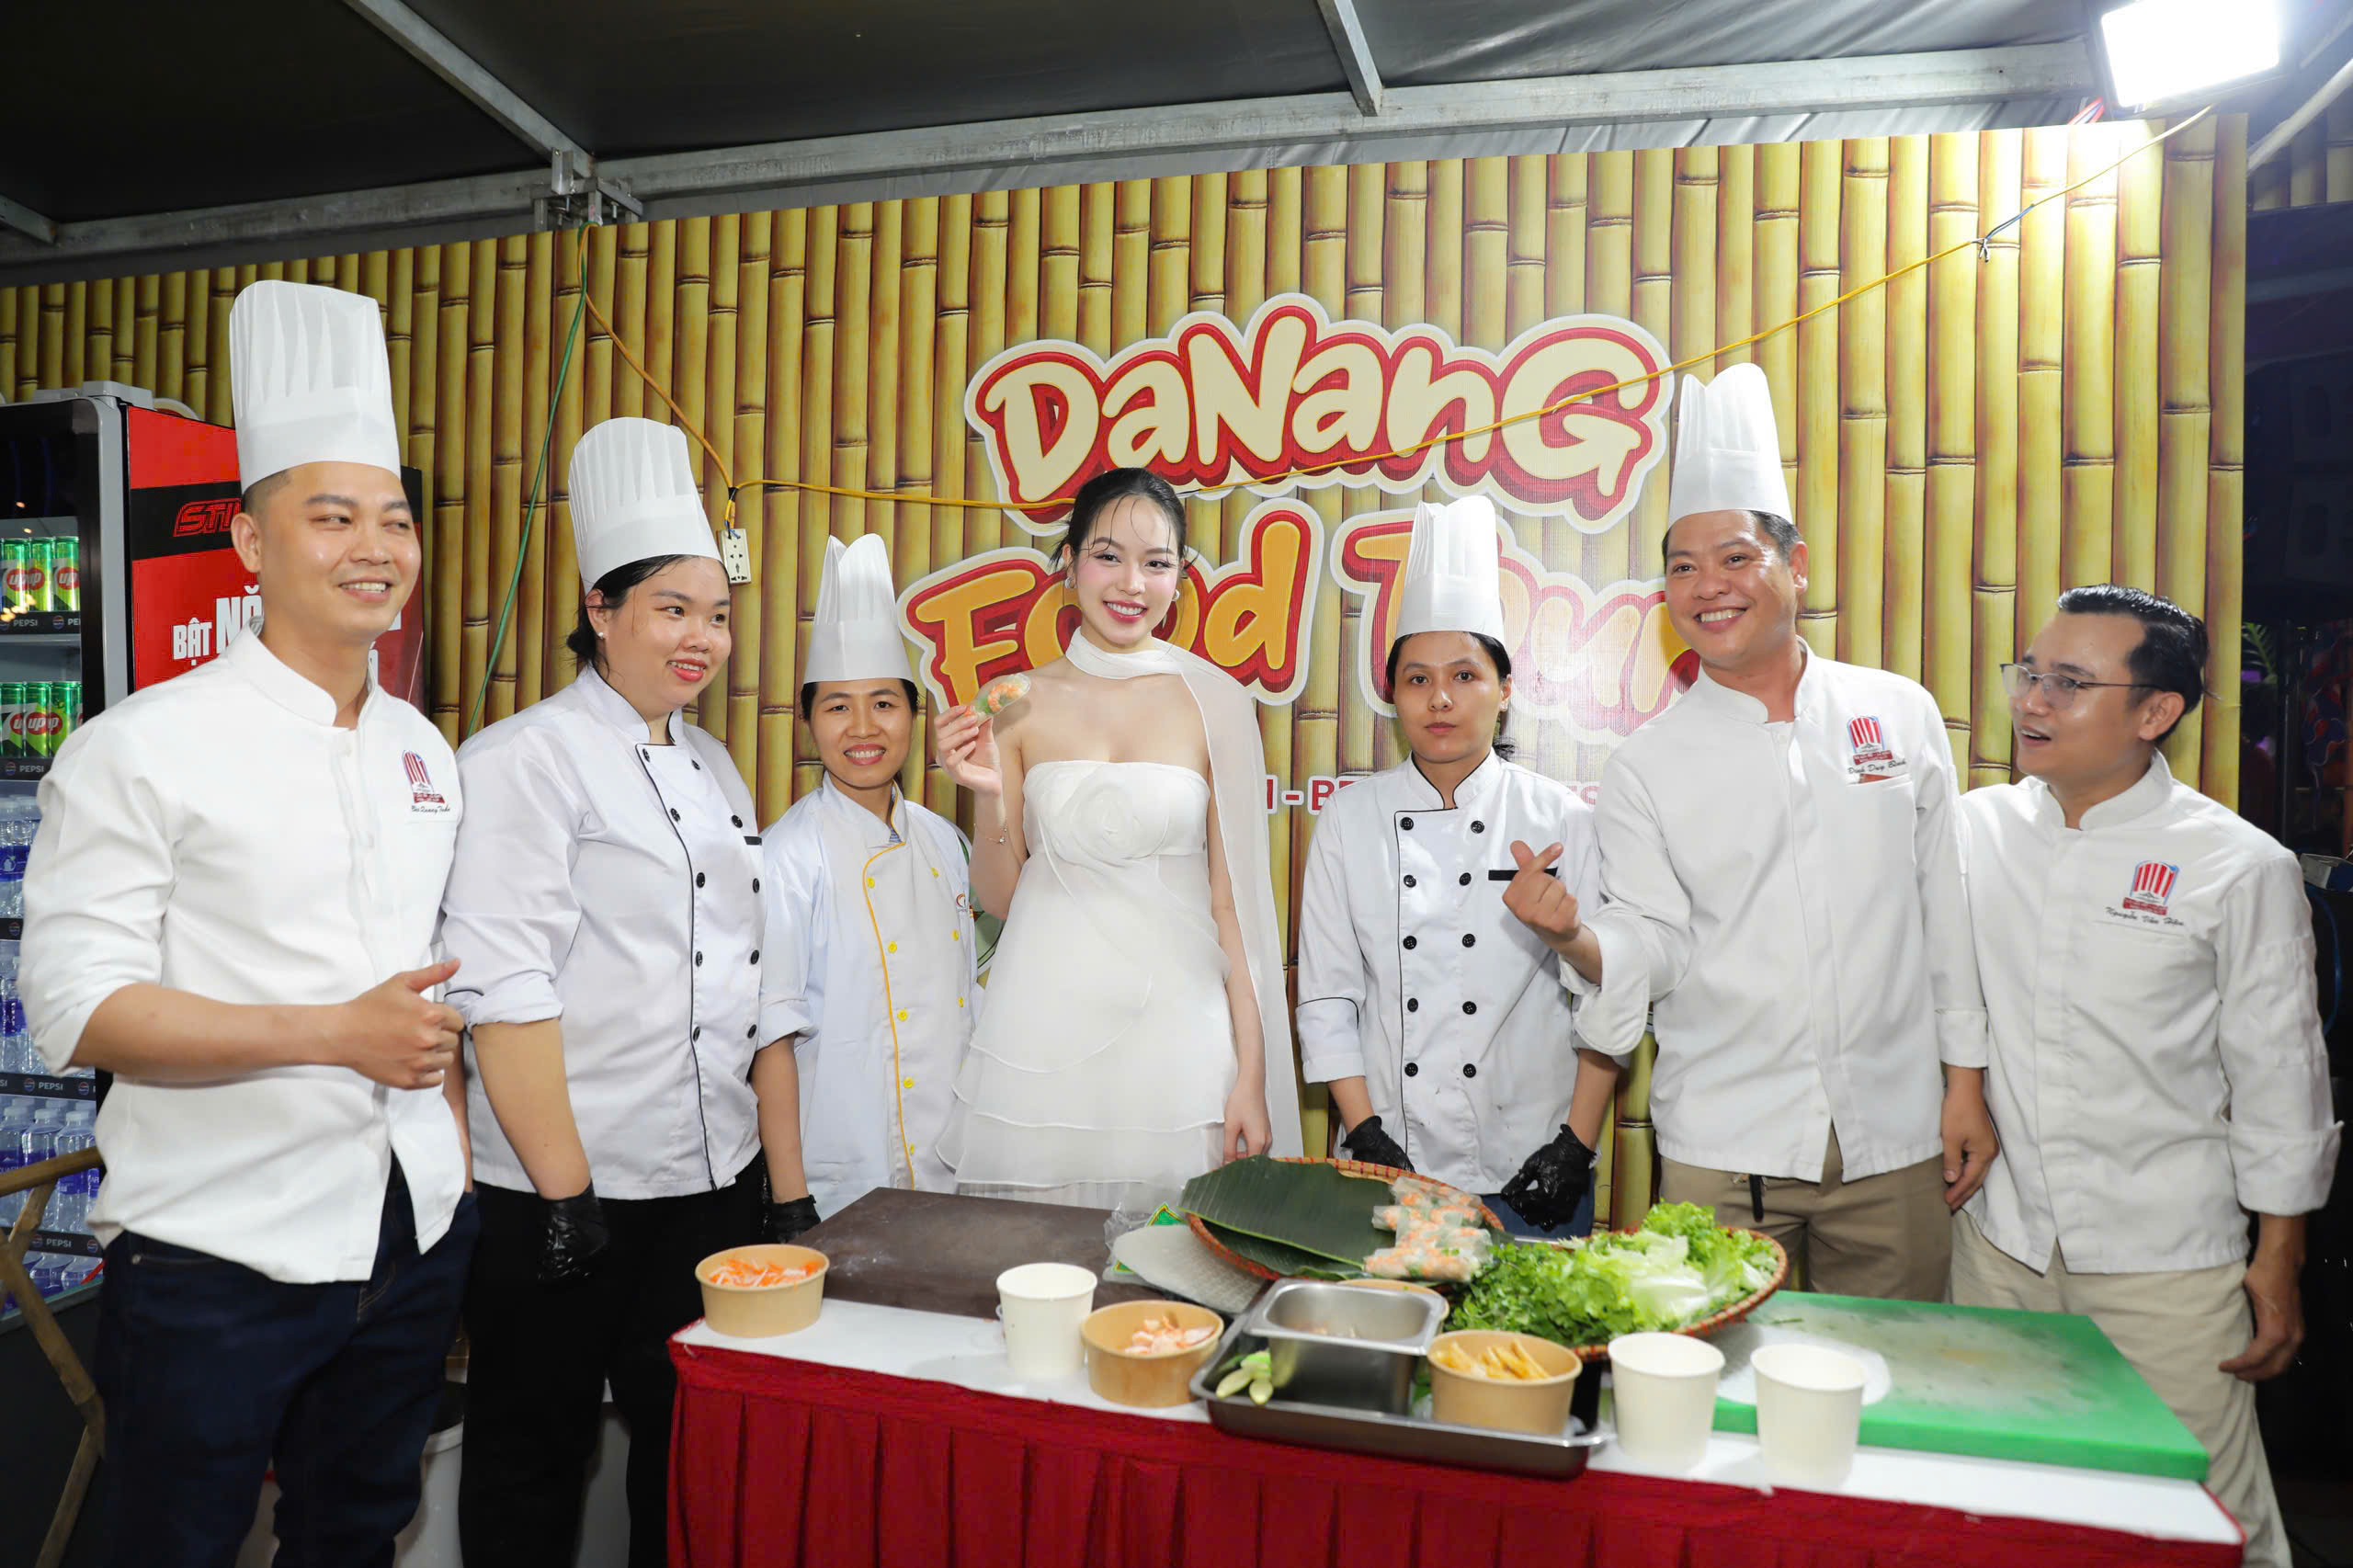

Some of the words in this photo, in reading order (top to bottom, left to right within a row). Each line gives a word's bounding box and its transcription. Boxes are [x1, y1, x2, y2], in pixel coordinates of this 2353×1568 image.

[13, 619, 38, 627] PEPSI
[173, 618, 212, 666] BẬT
[19, 765, 44, 773] PEPSI
[38, 1081, 63, 1091] PEPSI
[46, 1237, 72, 1248] PEPSI
